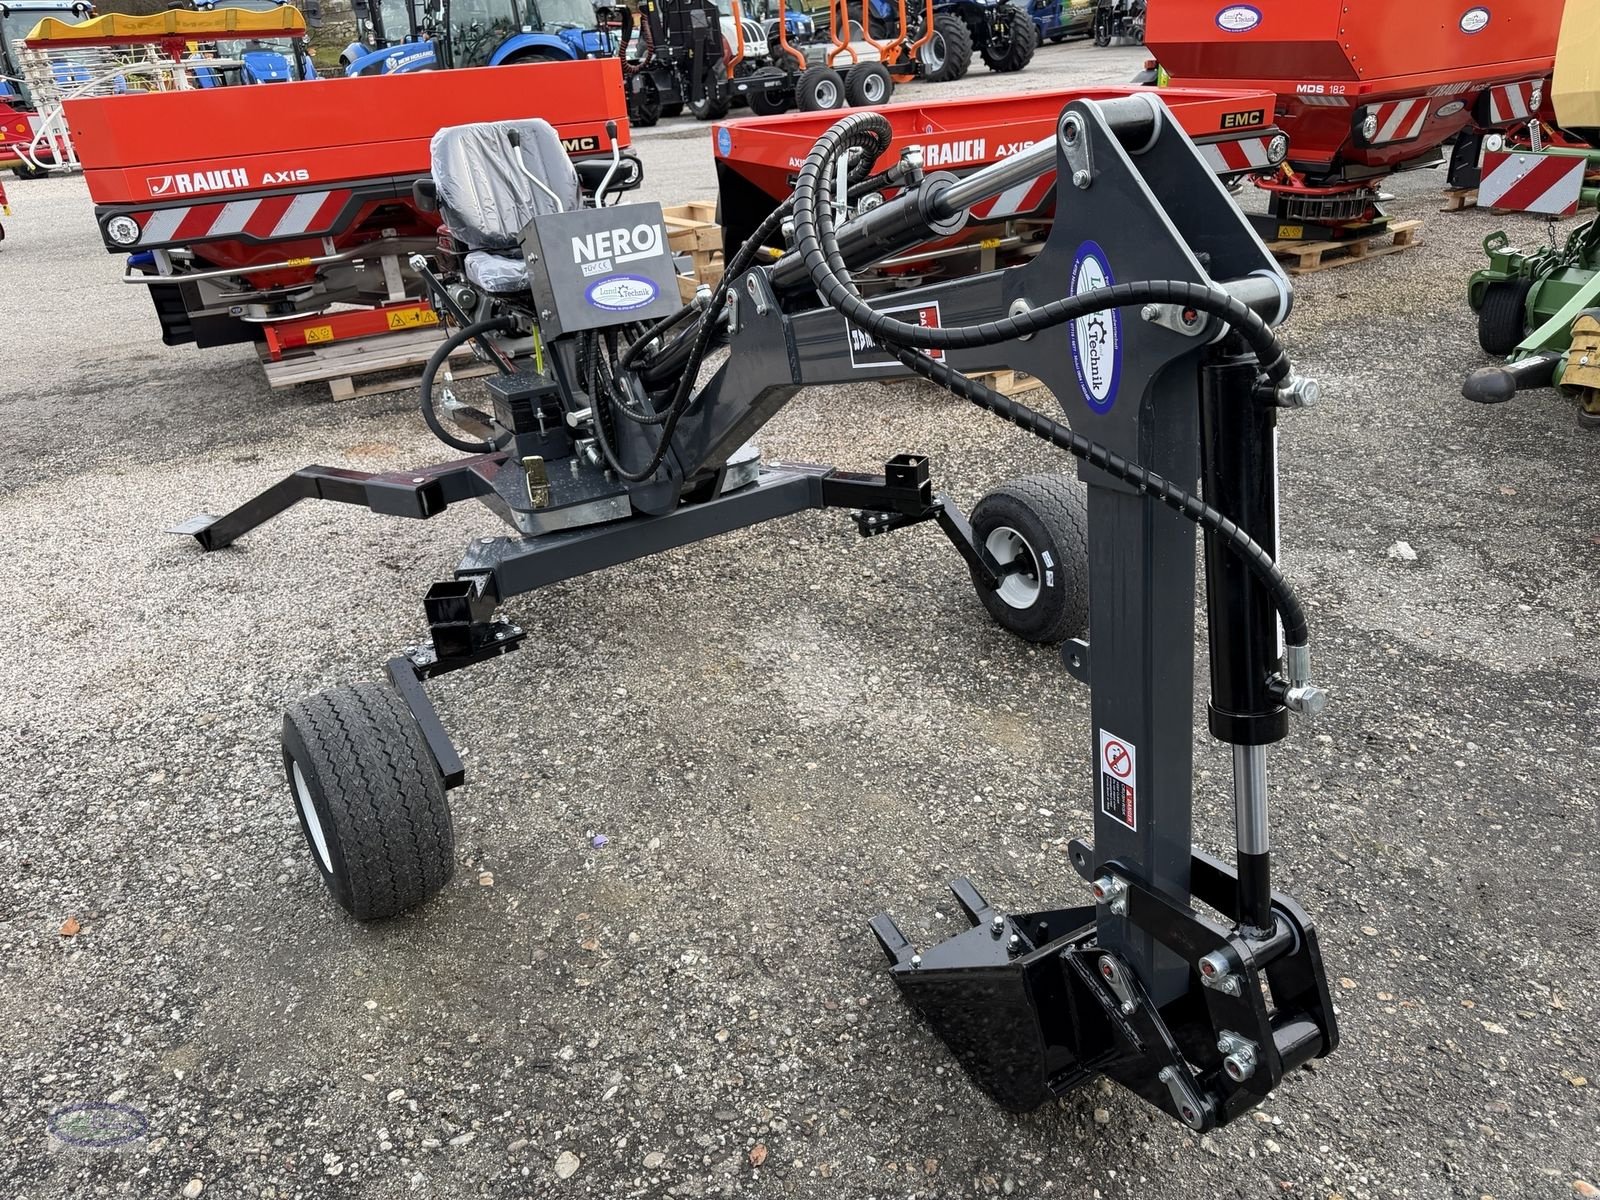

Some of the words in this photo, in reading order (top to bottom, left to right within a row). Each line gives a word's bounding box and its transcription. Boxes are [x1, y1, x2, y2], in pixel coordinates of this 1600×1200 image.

[410, 51, 434, 61] HOLLAND
[1296, 84, 1325, 93] MDS
[1224, 111, 1260, 127] EMC
[562, 138, 594, 152] MC
[927, 138, 986, 167] RAUCH
[175, 167, 249, 194] RAUCH
[262, 169, 310, 185] AXIS
[571, 223, 656, 264] NERO
[623, 287, 650, 298] Technik
[1089, 331, 1103, 390] Technik
